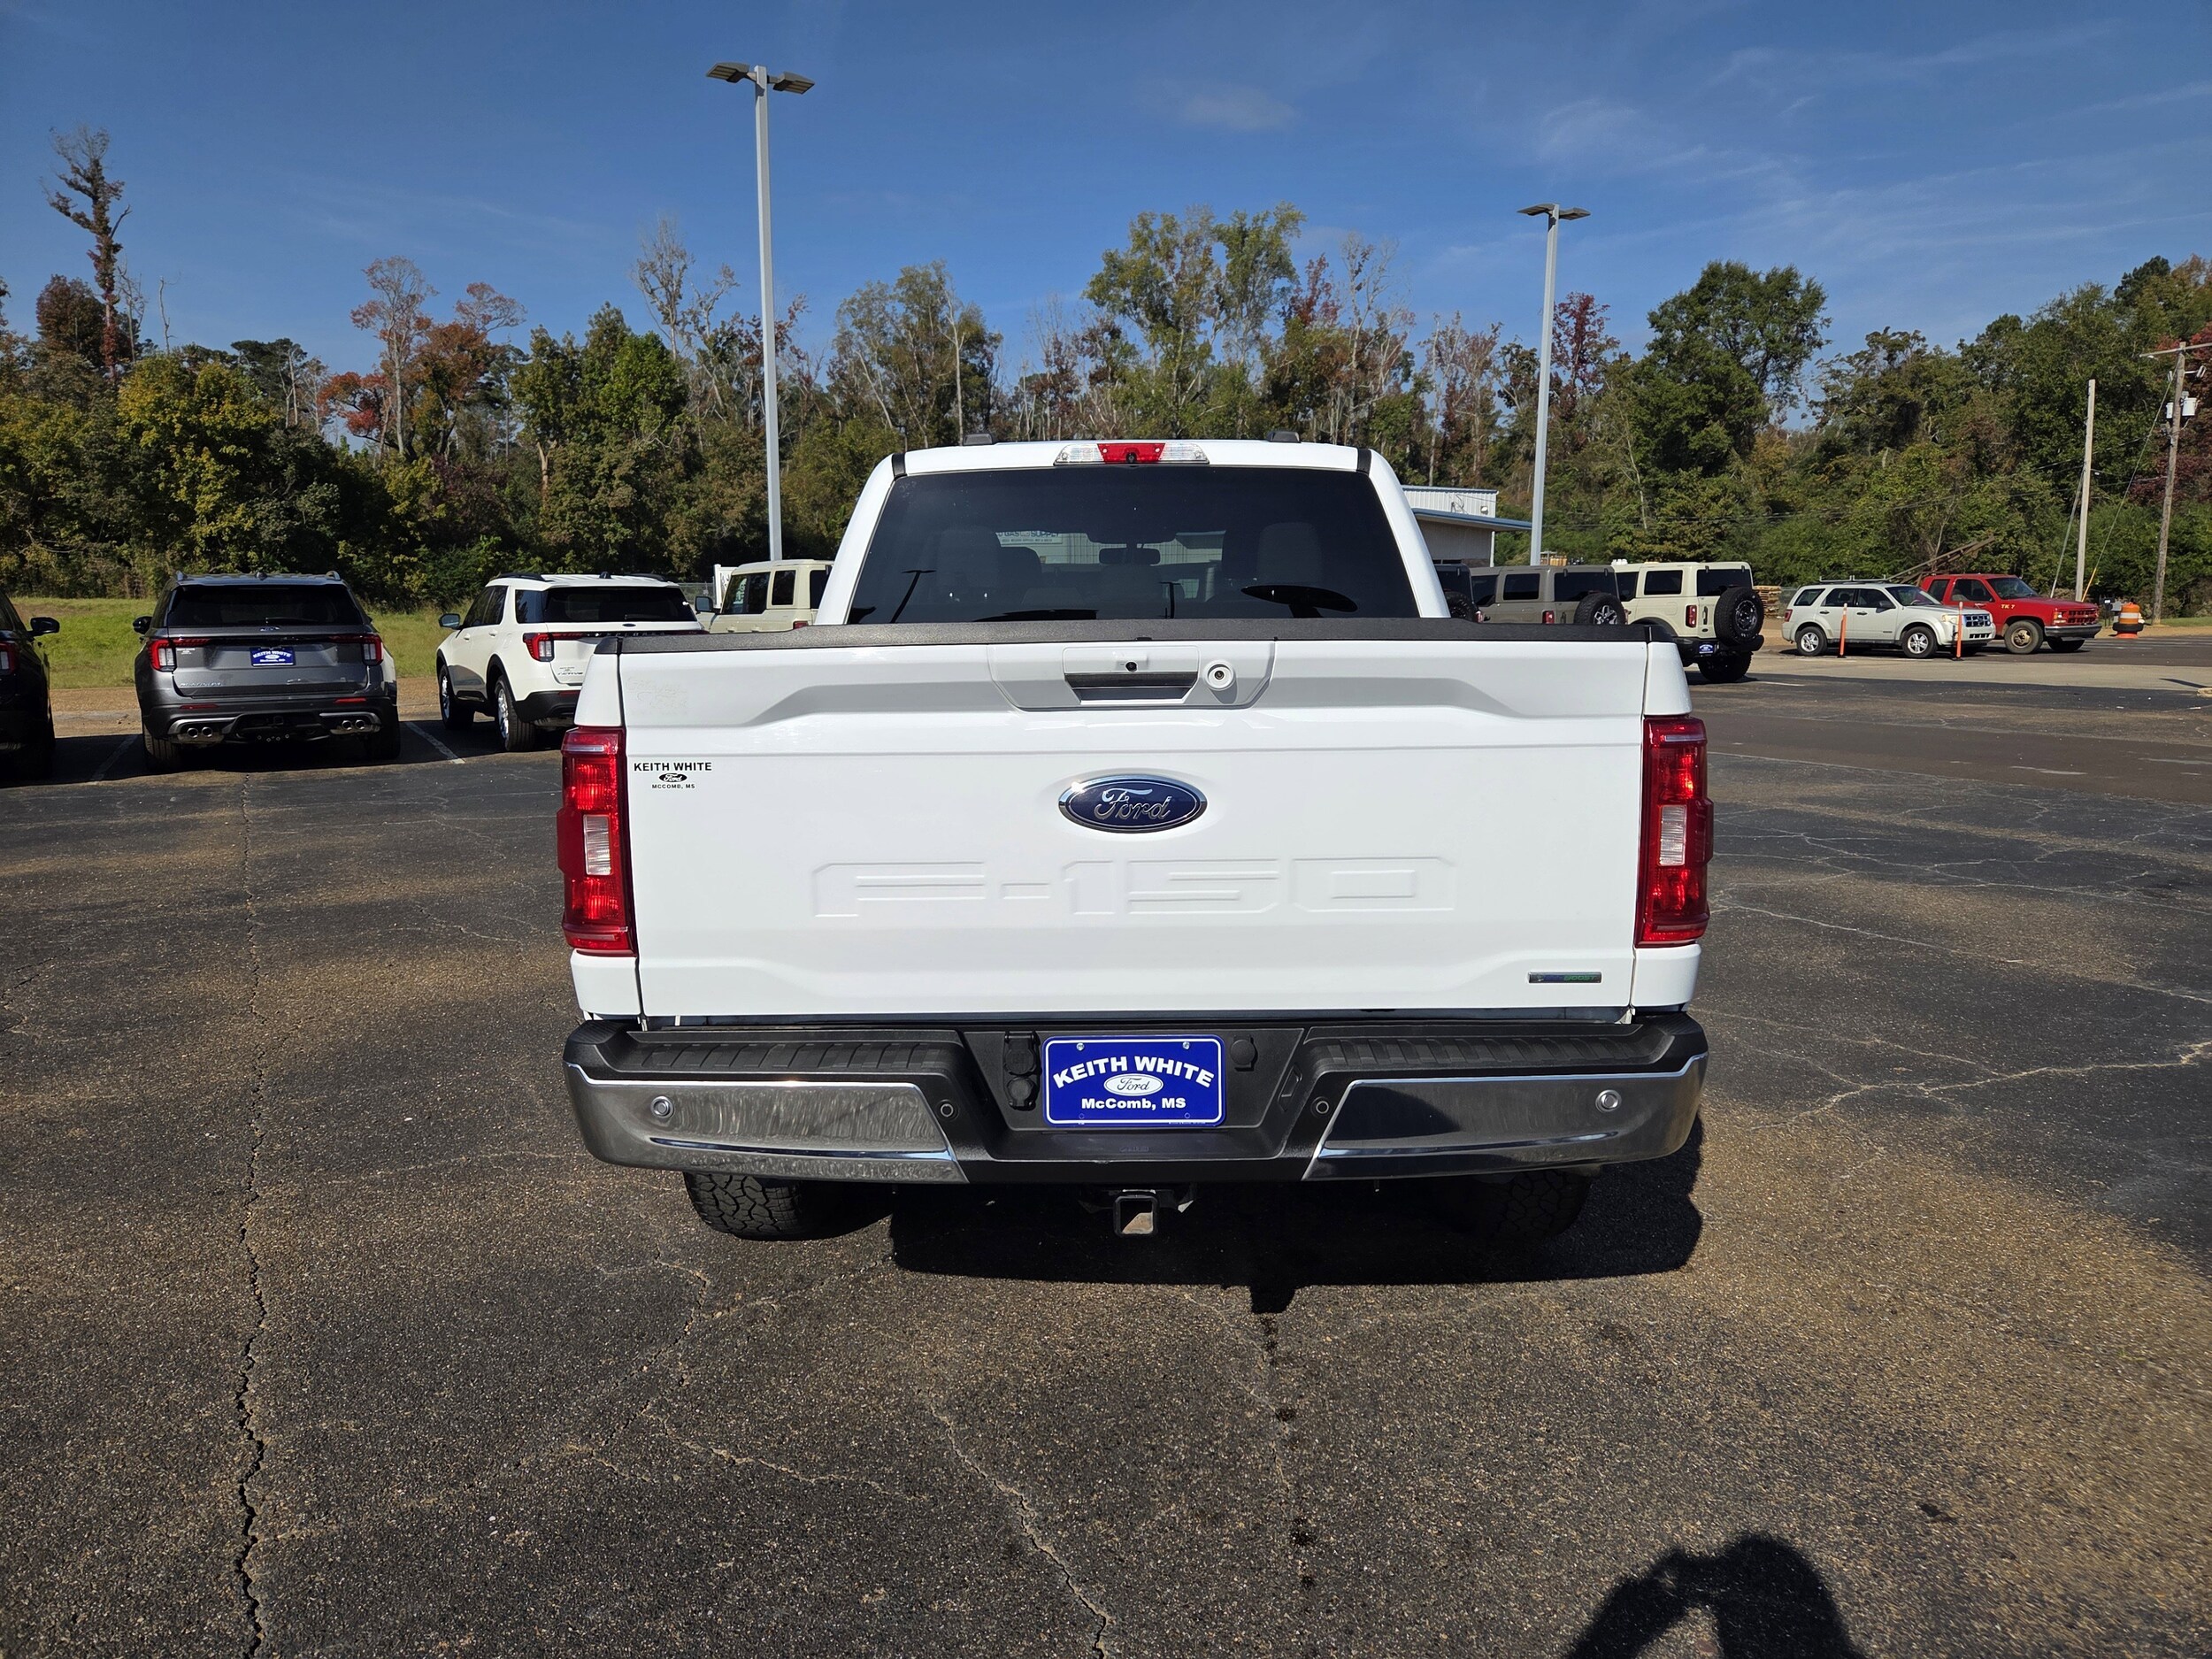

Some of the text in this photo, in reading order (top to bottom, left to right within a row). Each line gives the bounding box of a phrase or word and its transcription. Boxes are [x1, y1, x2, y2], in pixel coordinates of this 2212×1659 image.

[634, 762, 712, 772] KEITH WHITE
[1094, 787, 1172, 820] Ford
[812, 856, 1457, 918] F-150
[1053, 1056, 1215, 1089] KEITH WHITE
[1117, 1078, 1150, 1091] Ford
[1081, 1097, 1187, 1110] McComb, MS
